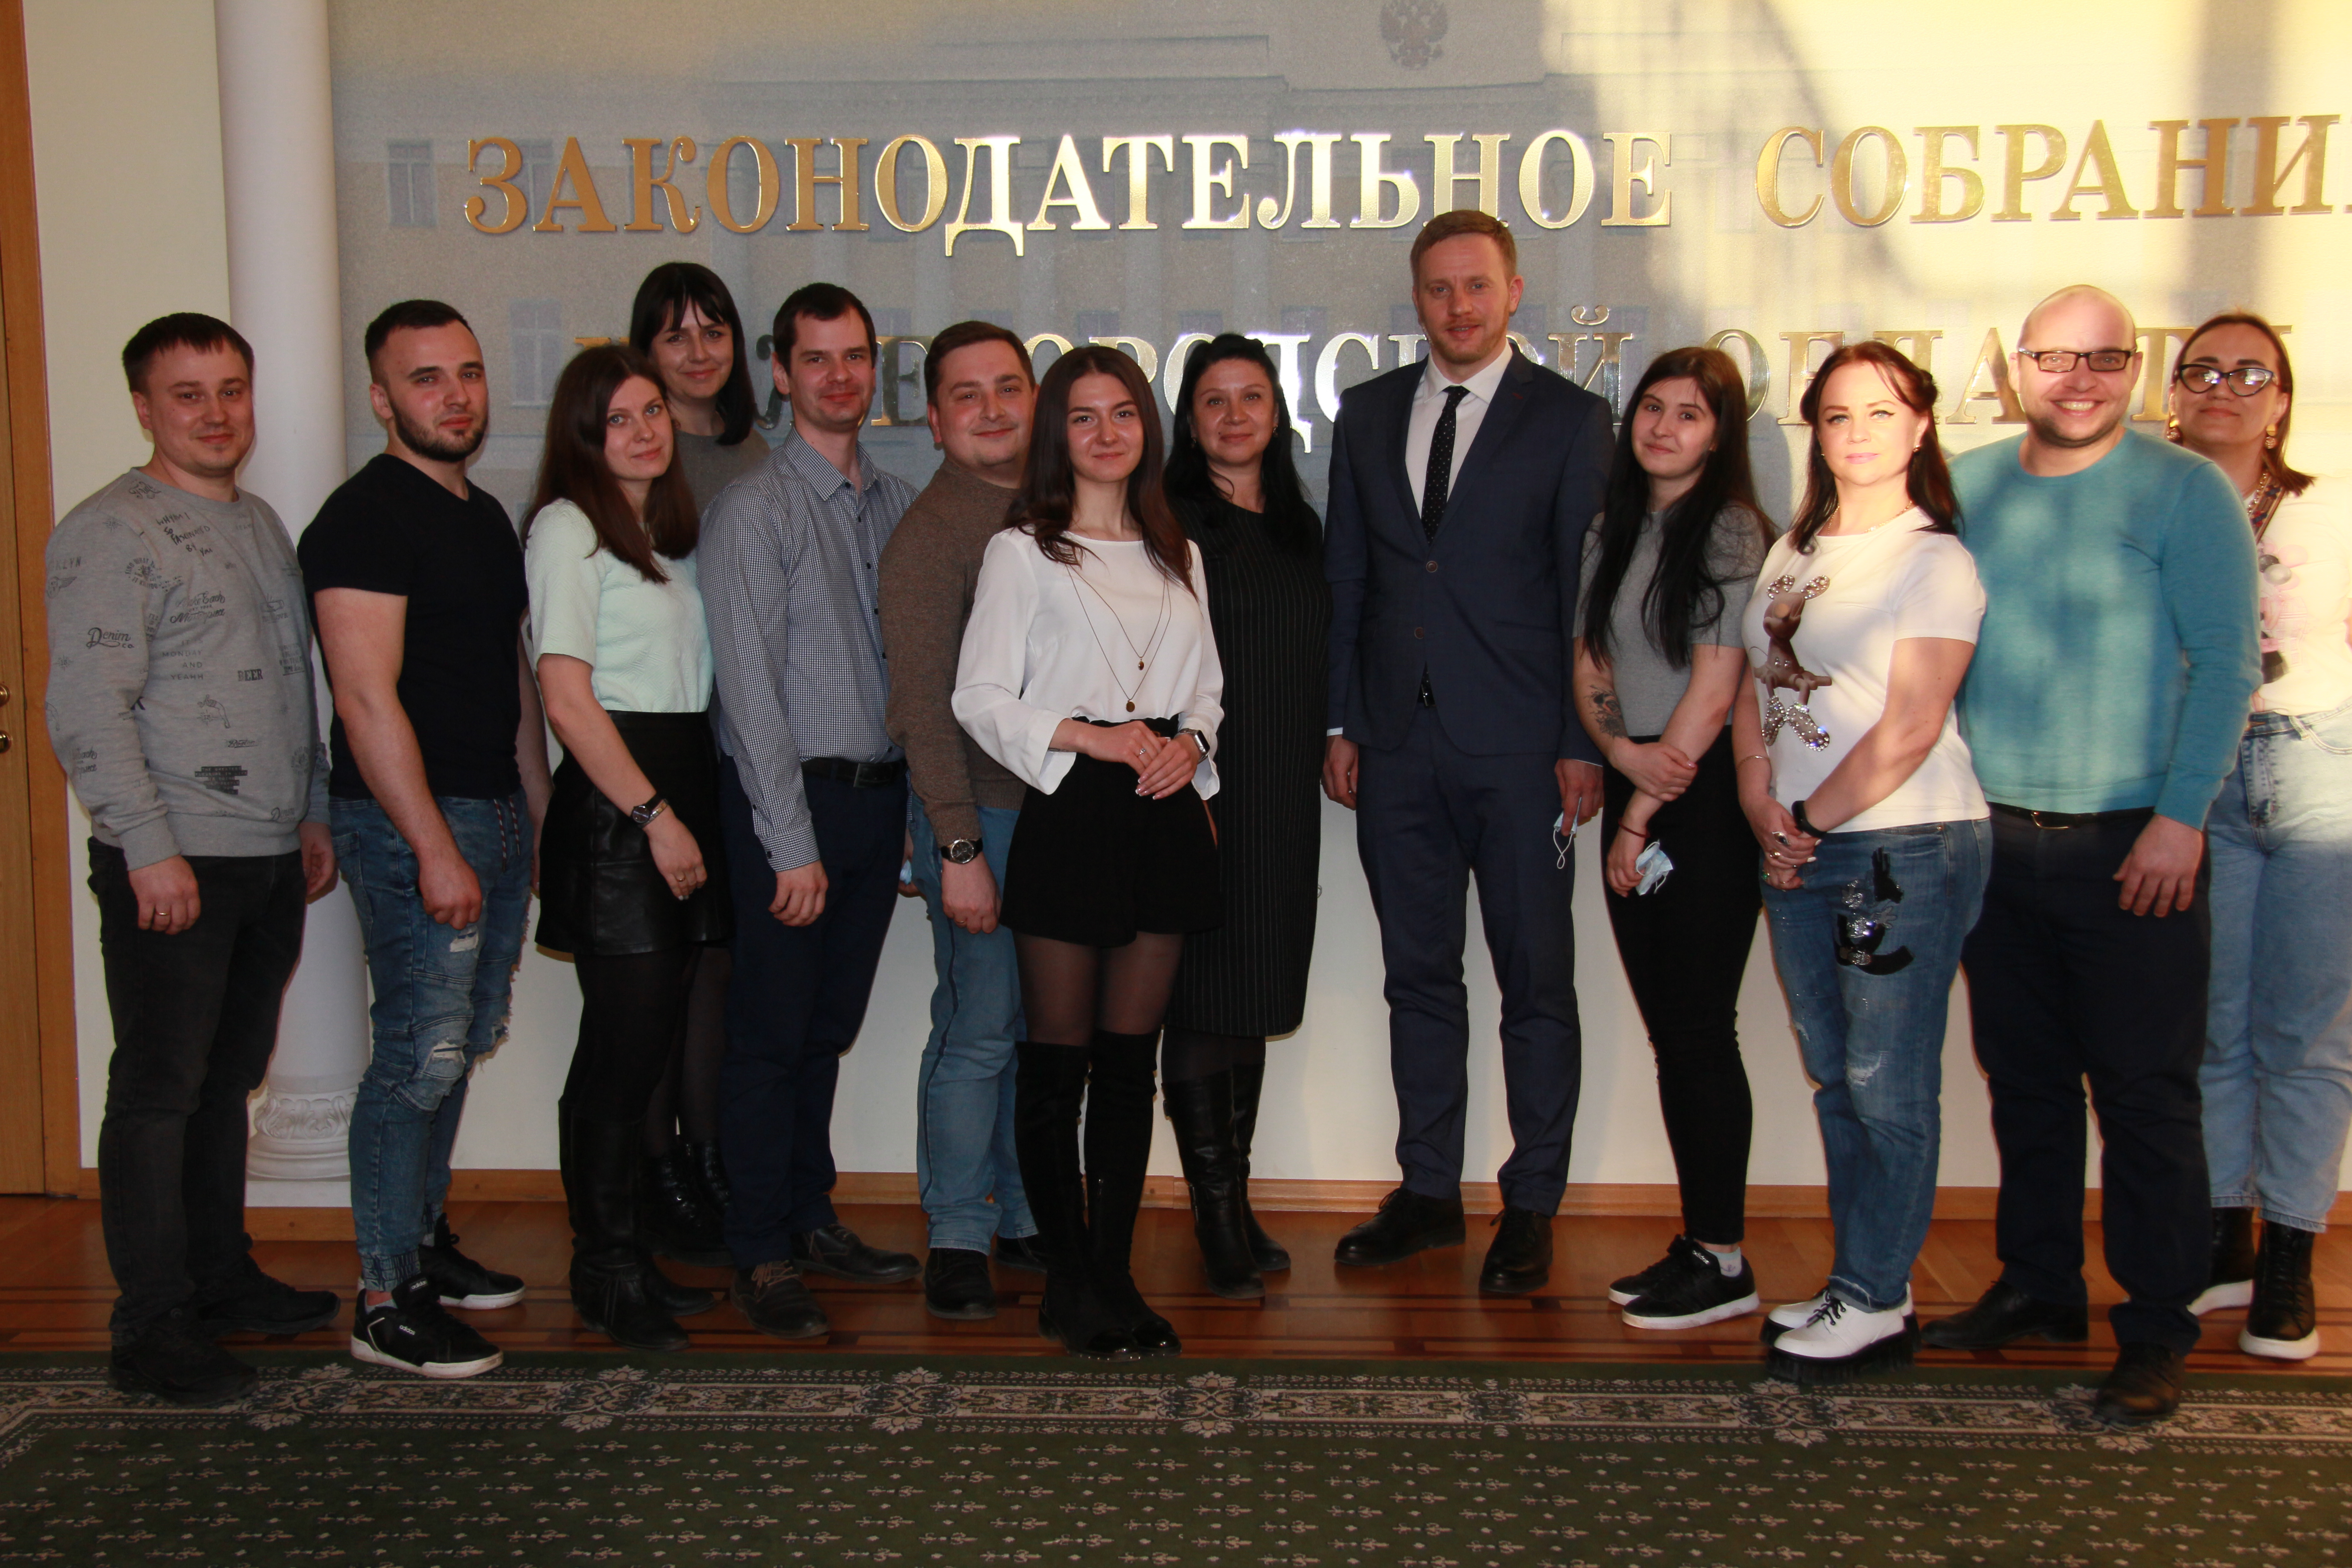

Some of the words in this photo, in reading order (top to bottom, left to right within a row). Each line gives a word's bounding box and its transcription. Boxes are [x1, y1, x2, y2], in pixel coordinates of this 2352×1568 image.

[464, 129, 1671, 256] ЗАКОНОДАТЕЛЬНОЕ
[1754, 114, 2352, 229] СОБРАНИ
[86, 627, 131, 650] Denim
[237, 668, 264, 681] BEER
[411, 1280, 427, 1289] adidas
[399, 1325, 416, 1335] adidas
